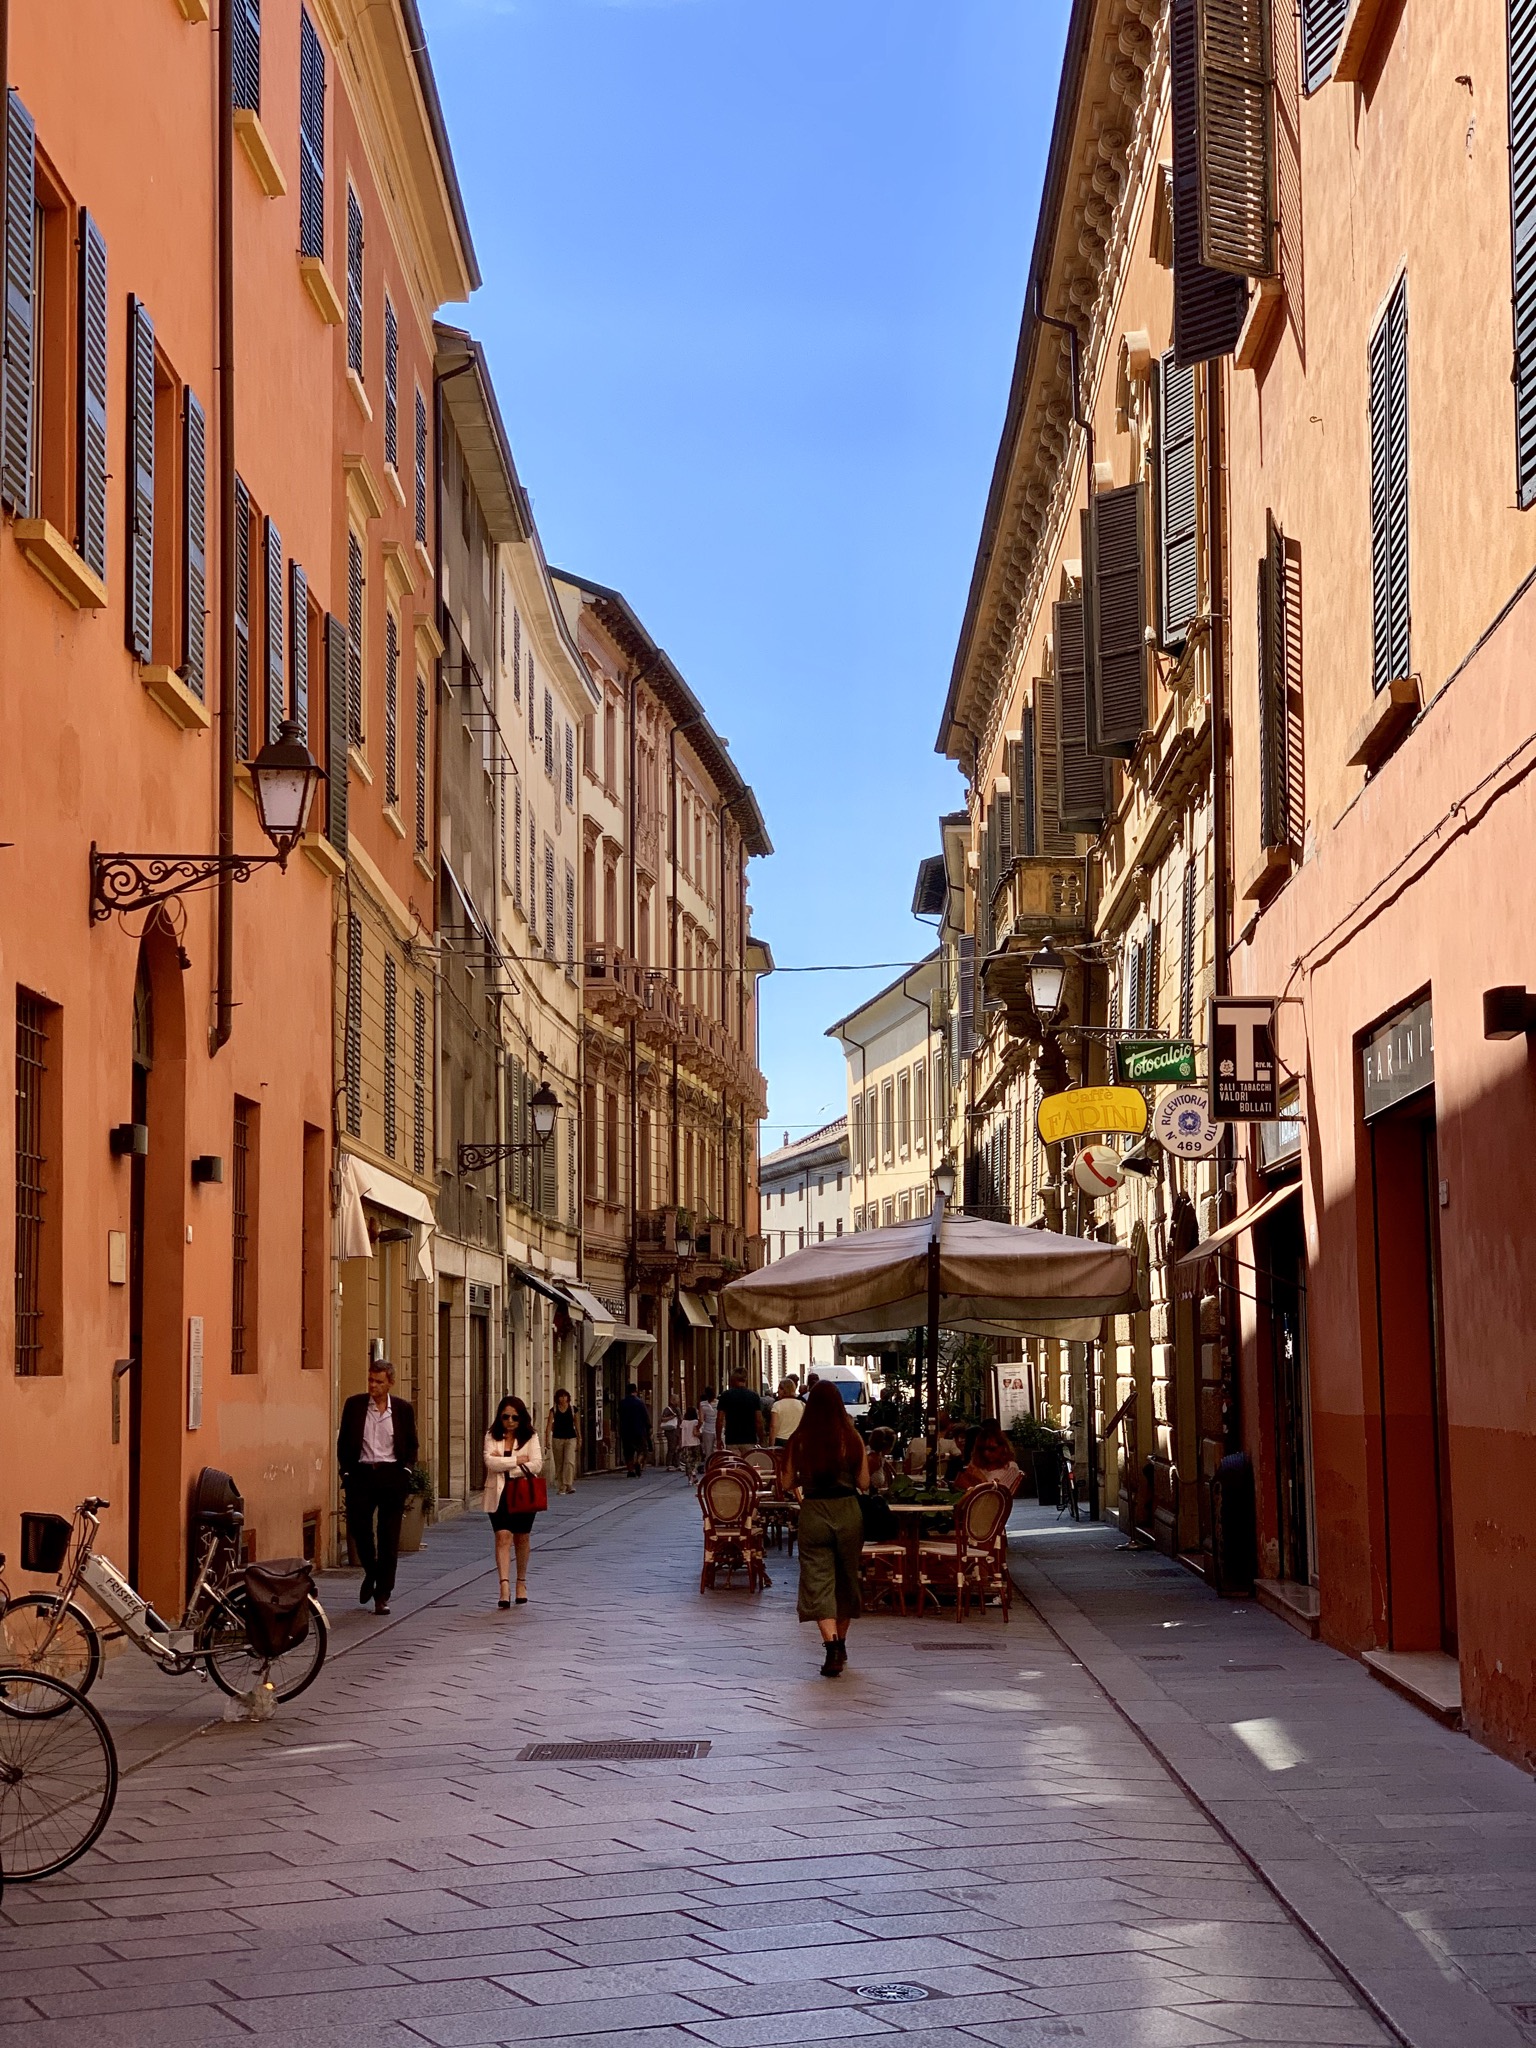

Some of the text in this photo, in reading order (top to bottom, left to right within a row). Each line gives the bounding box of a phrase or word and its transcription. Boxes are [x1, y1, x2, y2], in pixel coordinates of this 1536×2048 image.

[1217, 1007, 1271, 1081] T
[1367, 1024, 1423, 1088] FARINI
[1124, 1043, 1193, 1079] Totocalcio
[1066, 1088, 1114, 1104] Caffè
[1219, 1083, 1272, 1092] SALI TABACCHI
[1219, 1091, 1248, 1102] VALORI
[1047, 1104, 1140, 1138] FARINI
[1161, 1094, 1218, 1142] RICEVITORIA TTO
[1239, 1102, 1272, 1113] BOLLATI
[1165, 1131, 1202, 1152] N. 469
